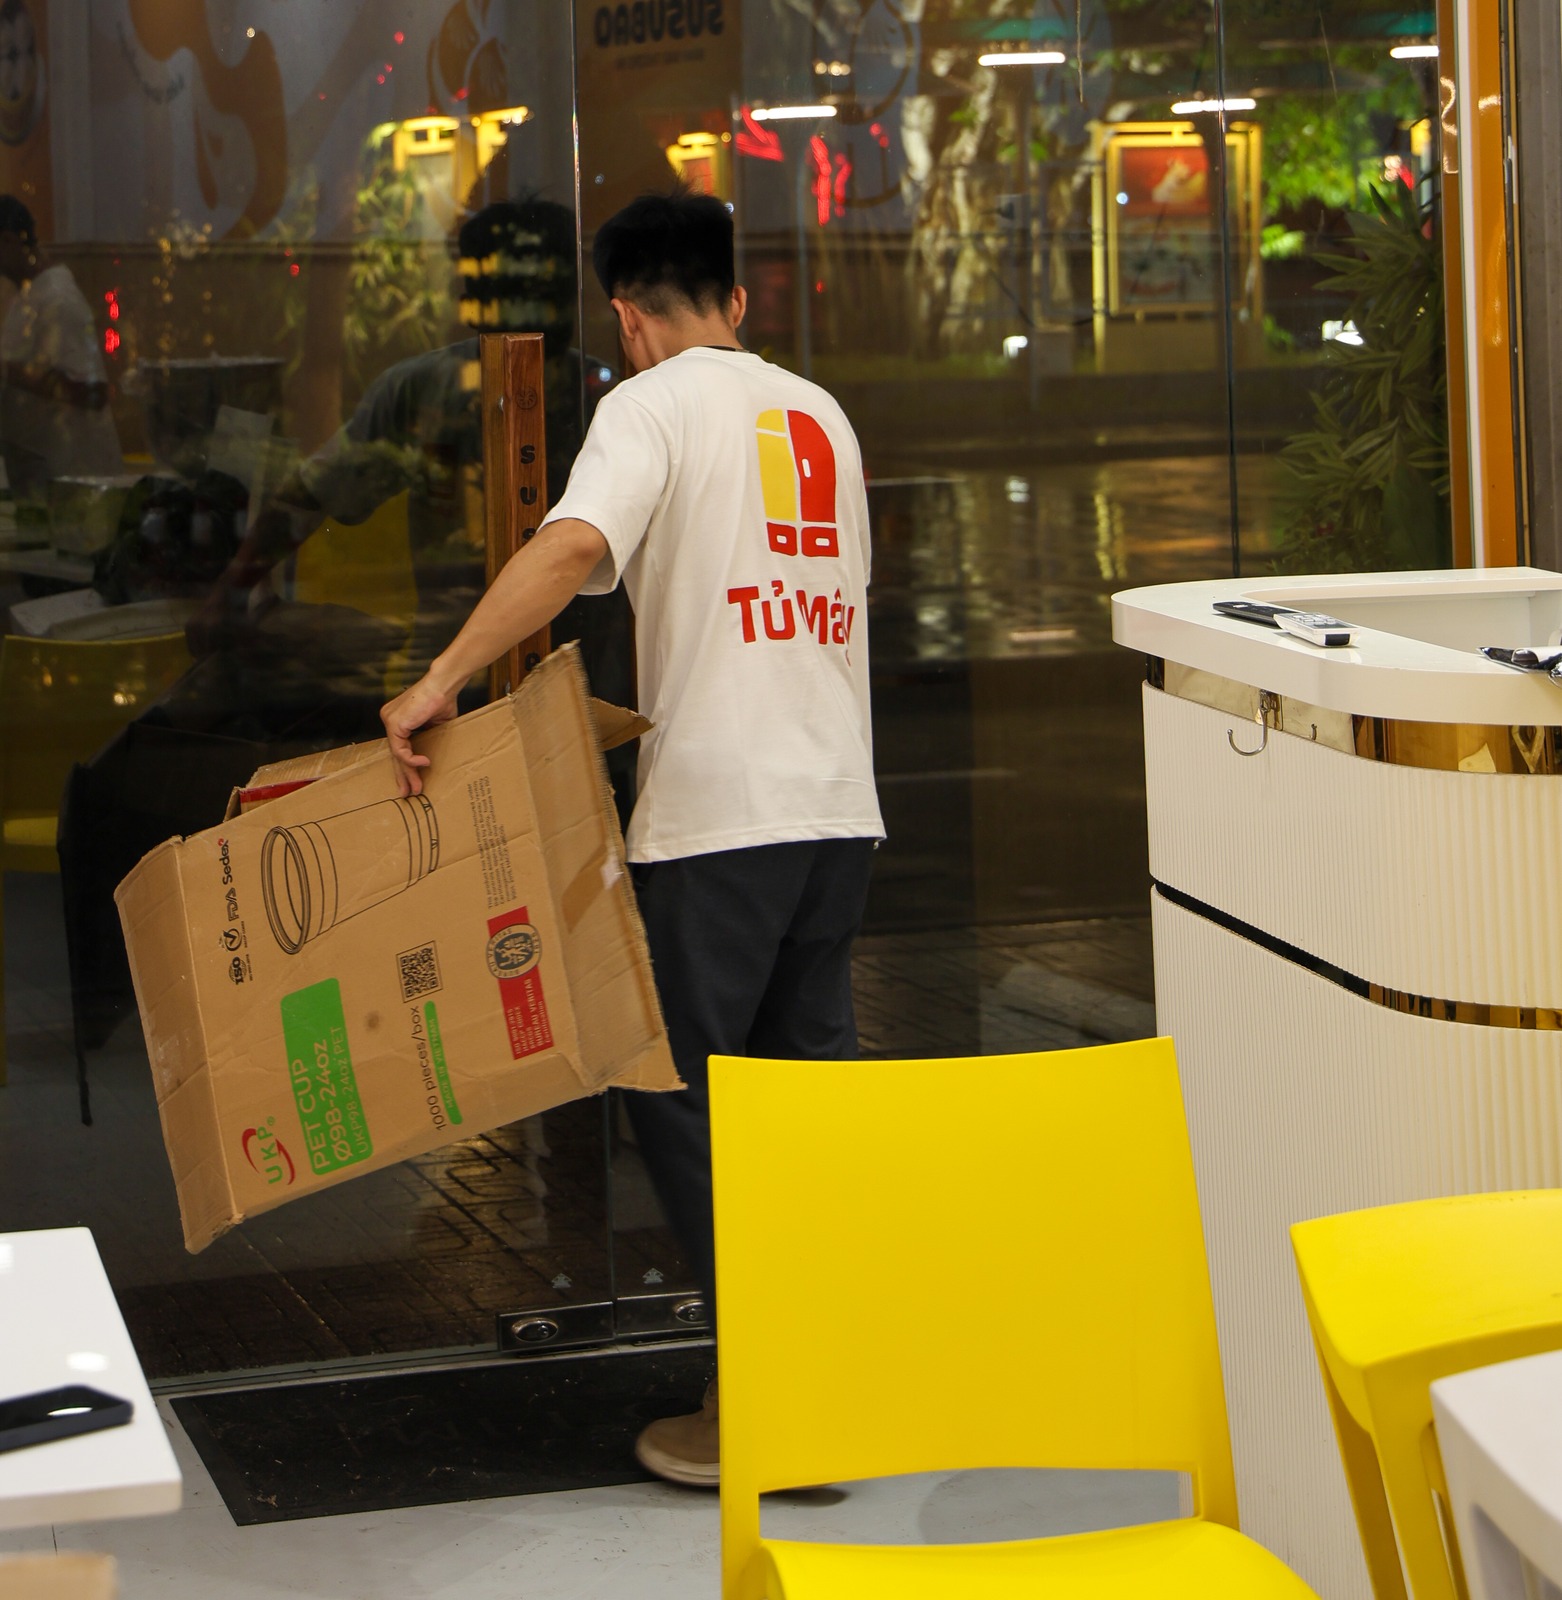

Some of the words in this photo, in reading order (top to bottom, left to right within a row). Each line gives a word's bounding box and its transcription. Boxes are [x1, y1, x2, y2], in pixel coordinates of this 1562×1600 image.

[217, 838, 232, 885] Sedex
[225, 887, 239, 921] FDA
[231, 956, 244, 985] ISO
[330, 1026, 344, 1055] PET
[531, 1014, 544, 1047] BUREAU
[410, 1005, 437, 1091] pieces/box
[292, 1058, 316, 1114] CUP
[439, 1066, 445, 1077] IN
[442, 1080, 453, 1108] MADE
[427, 1095, 447, 1131] 1000
[304, 1120, 330, 1170] PET
